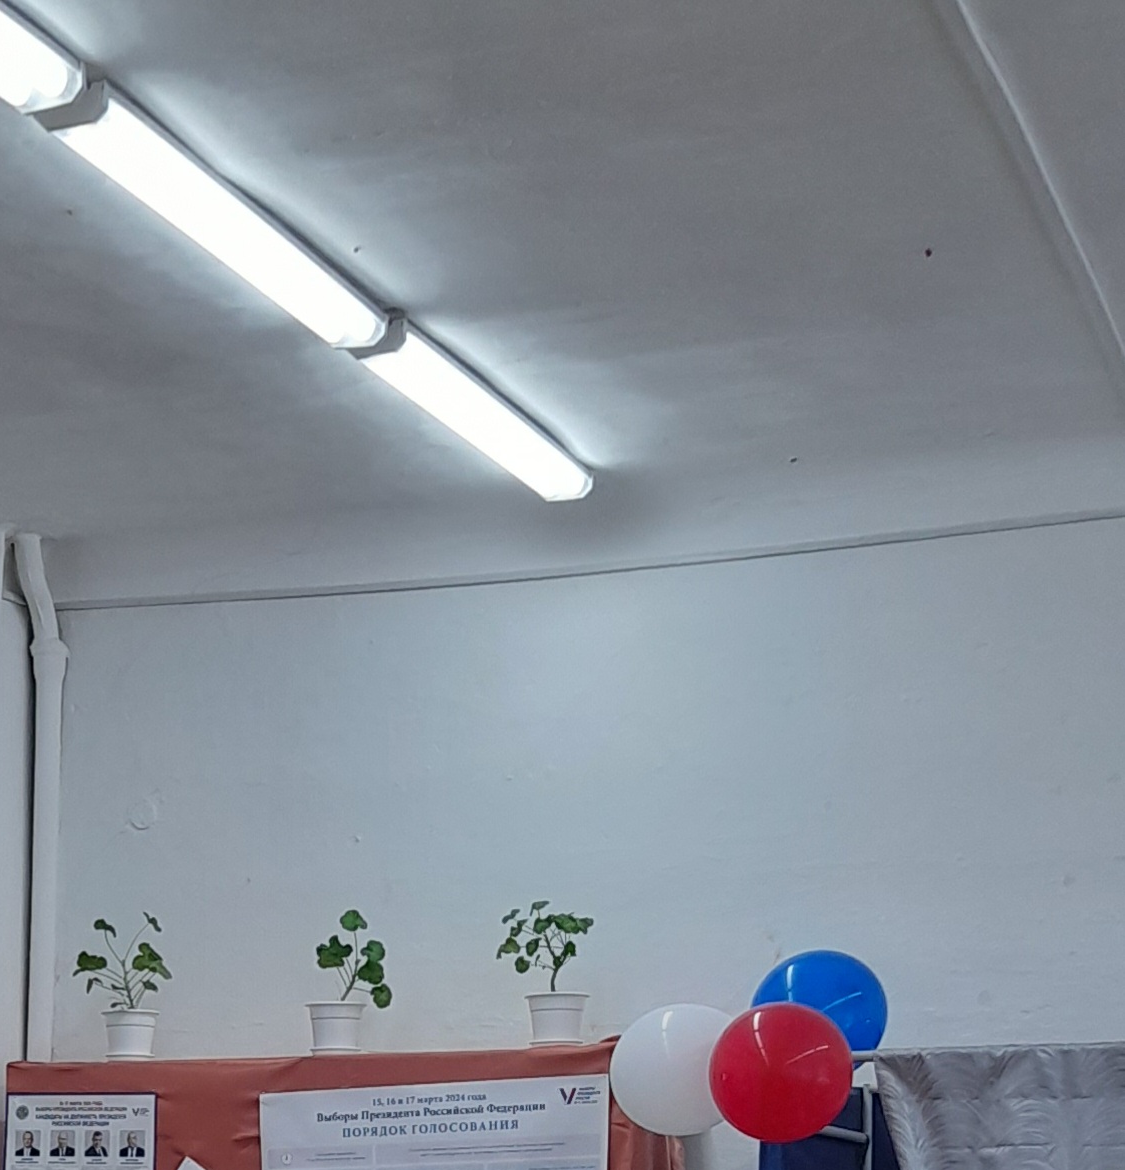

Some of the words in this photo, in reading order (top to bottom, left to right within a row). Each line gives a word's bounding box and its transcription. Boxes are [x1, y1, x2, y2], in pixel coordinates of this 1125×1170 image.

[406, 1096, 415, 1104] 17
[417, 1095, 443, 1105] марта
[445, 1094, 465, 1102] 2024
[467, 1093, 487, 1101] года
[317, 1112, 359, 1123] Выборы
[361, 1109, 421, 1122] Президента
[423, 1104, 485, 1116] Российской
[486, 1103, 546, 1114] Федерации
[342, 1125, 407, 1138] ПОРЯДОК
[411, 1119, 520, 1135] ГОЛОСОВАНИЯ
